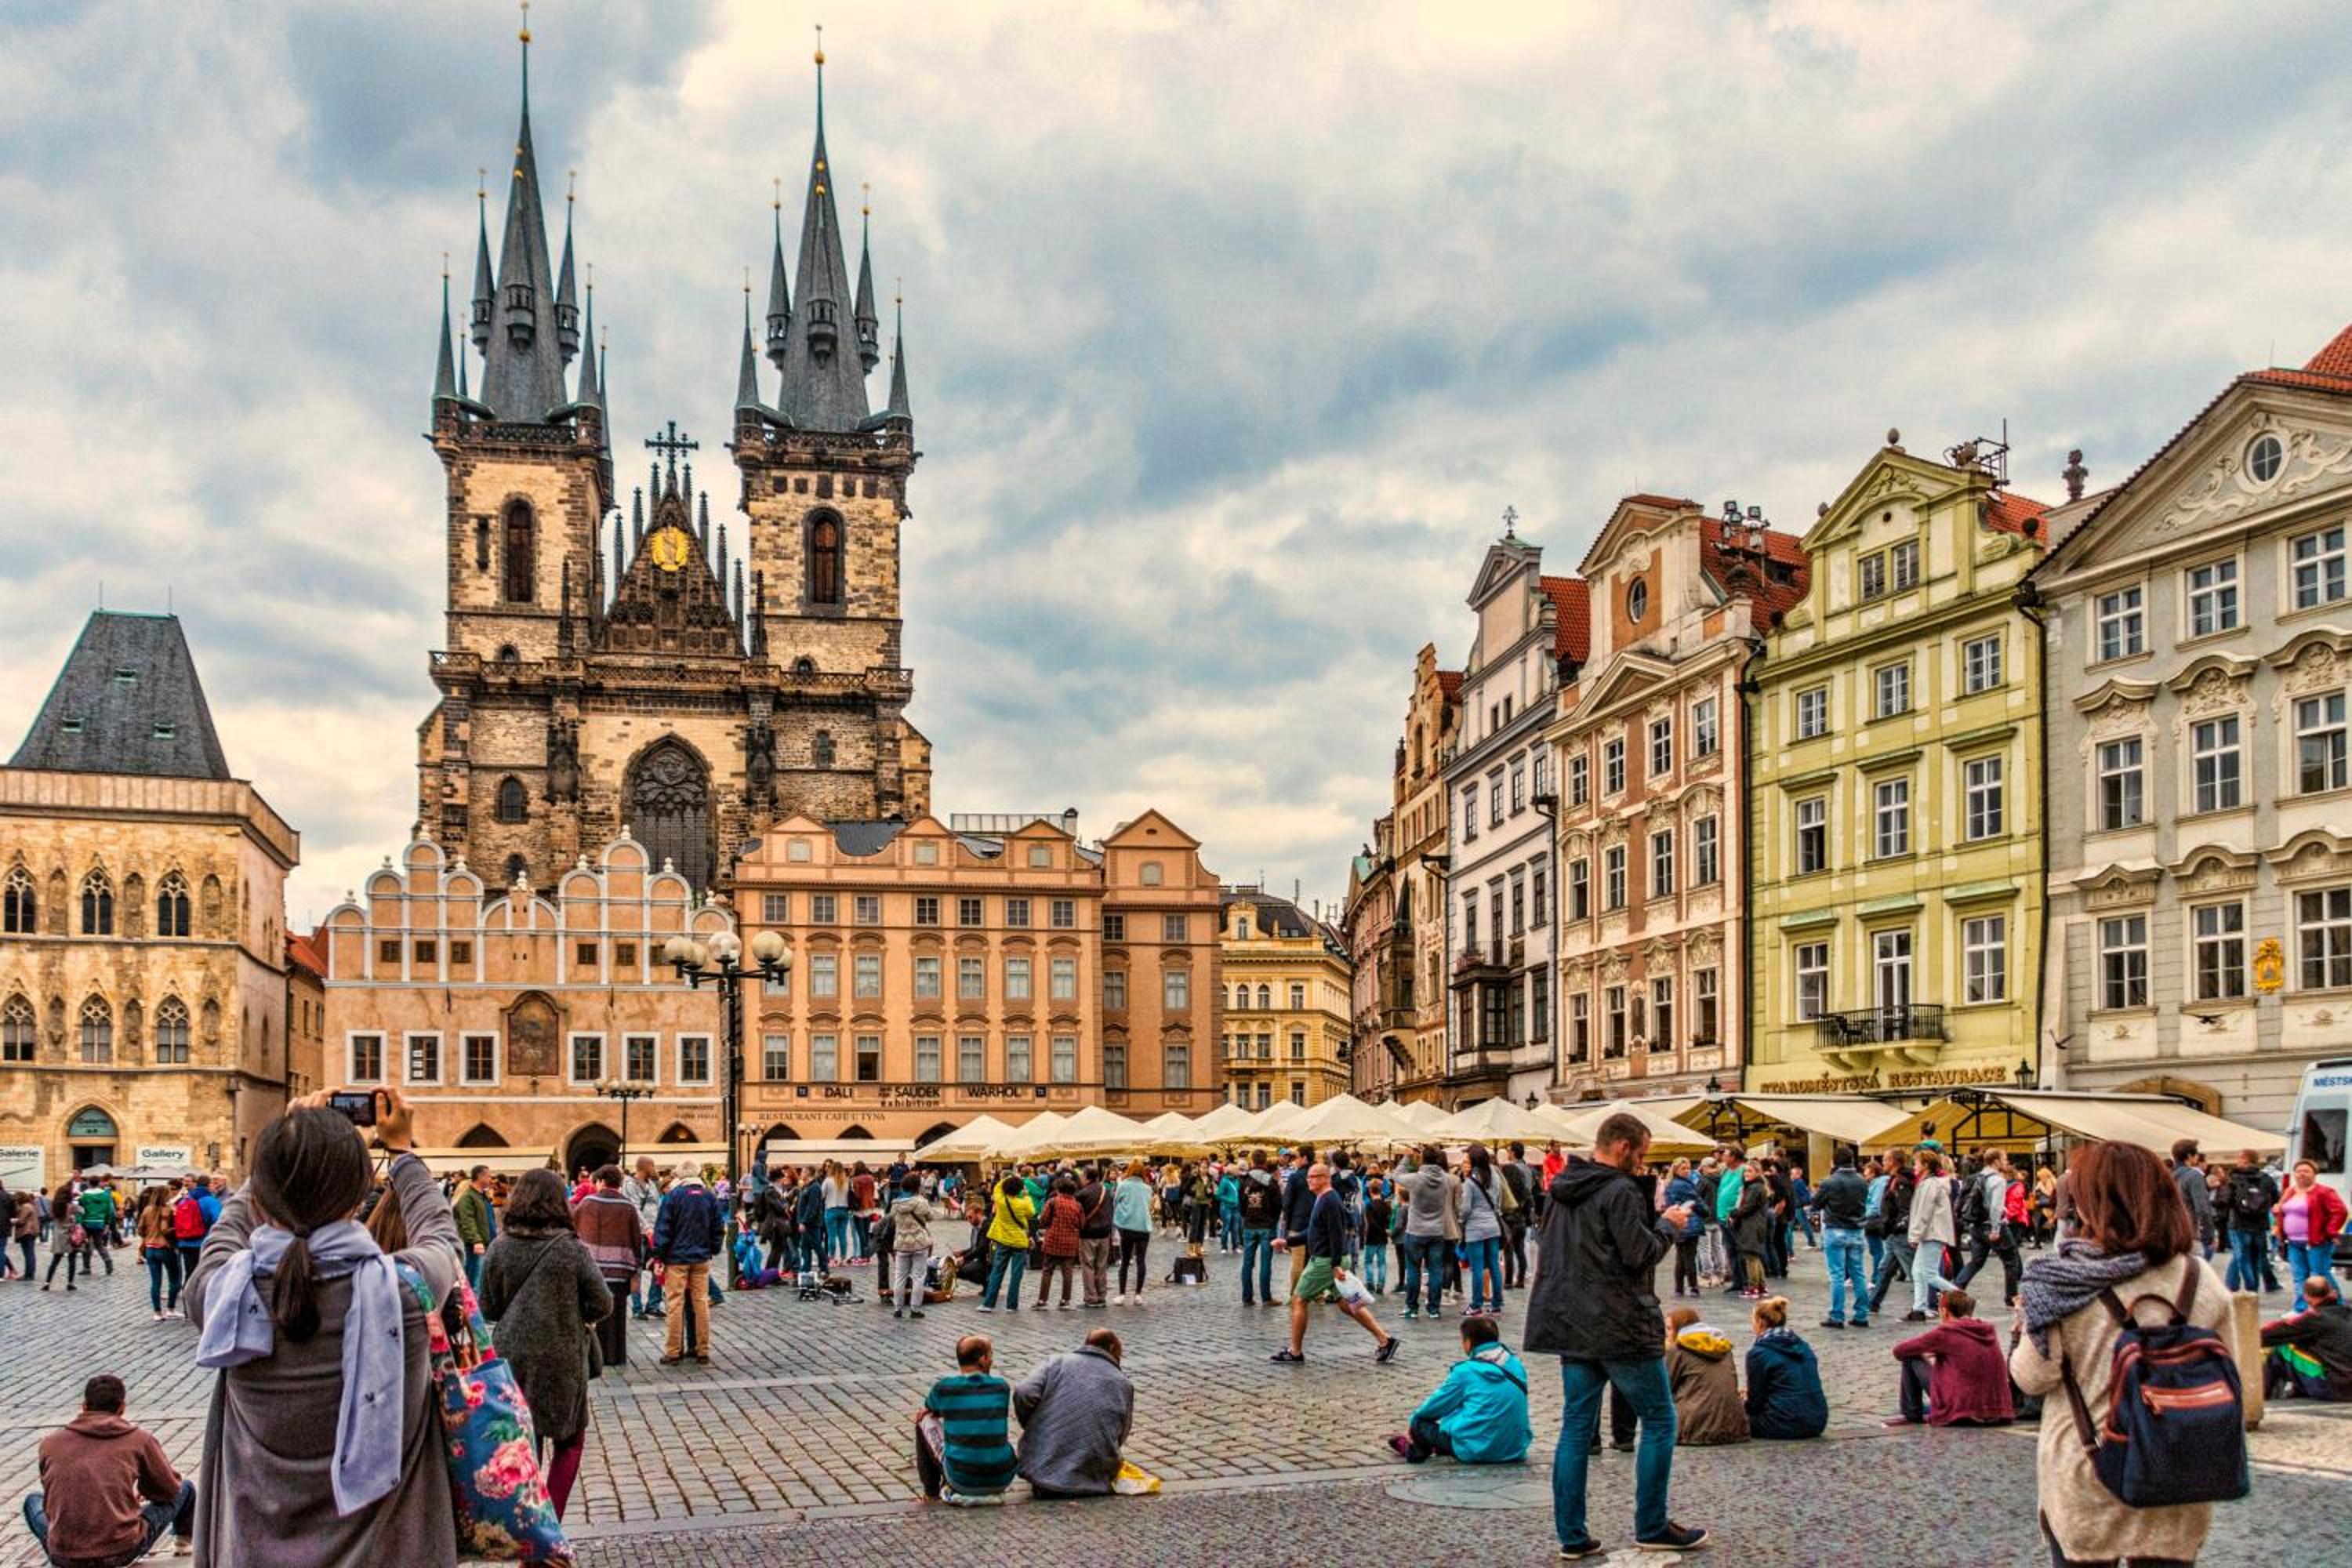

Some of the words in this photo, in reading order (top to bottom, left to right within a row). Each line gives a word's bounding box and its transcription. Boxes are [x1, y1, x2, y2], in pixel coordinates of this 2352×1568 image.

[1889, 1066, 2006, 1087] RESTAURACE
[895, 1085, 940, 1098] SAUDEK
[967, 1085, 1022, 1098] WARHOL
[880, 1098, 939, 1108] exhibition
[758, 1112, 822, 1121] RESTAURANT
[142, 1149, 185, 1159] Gallery
